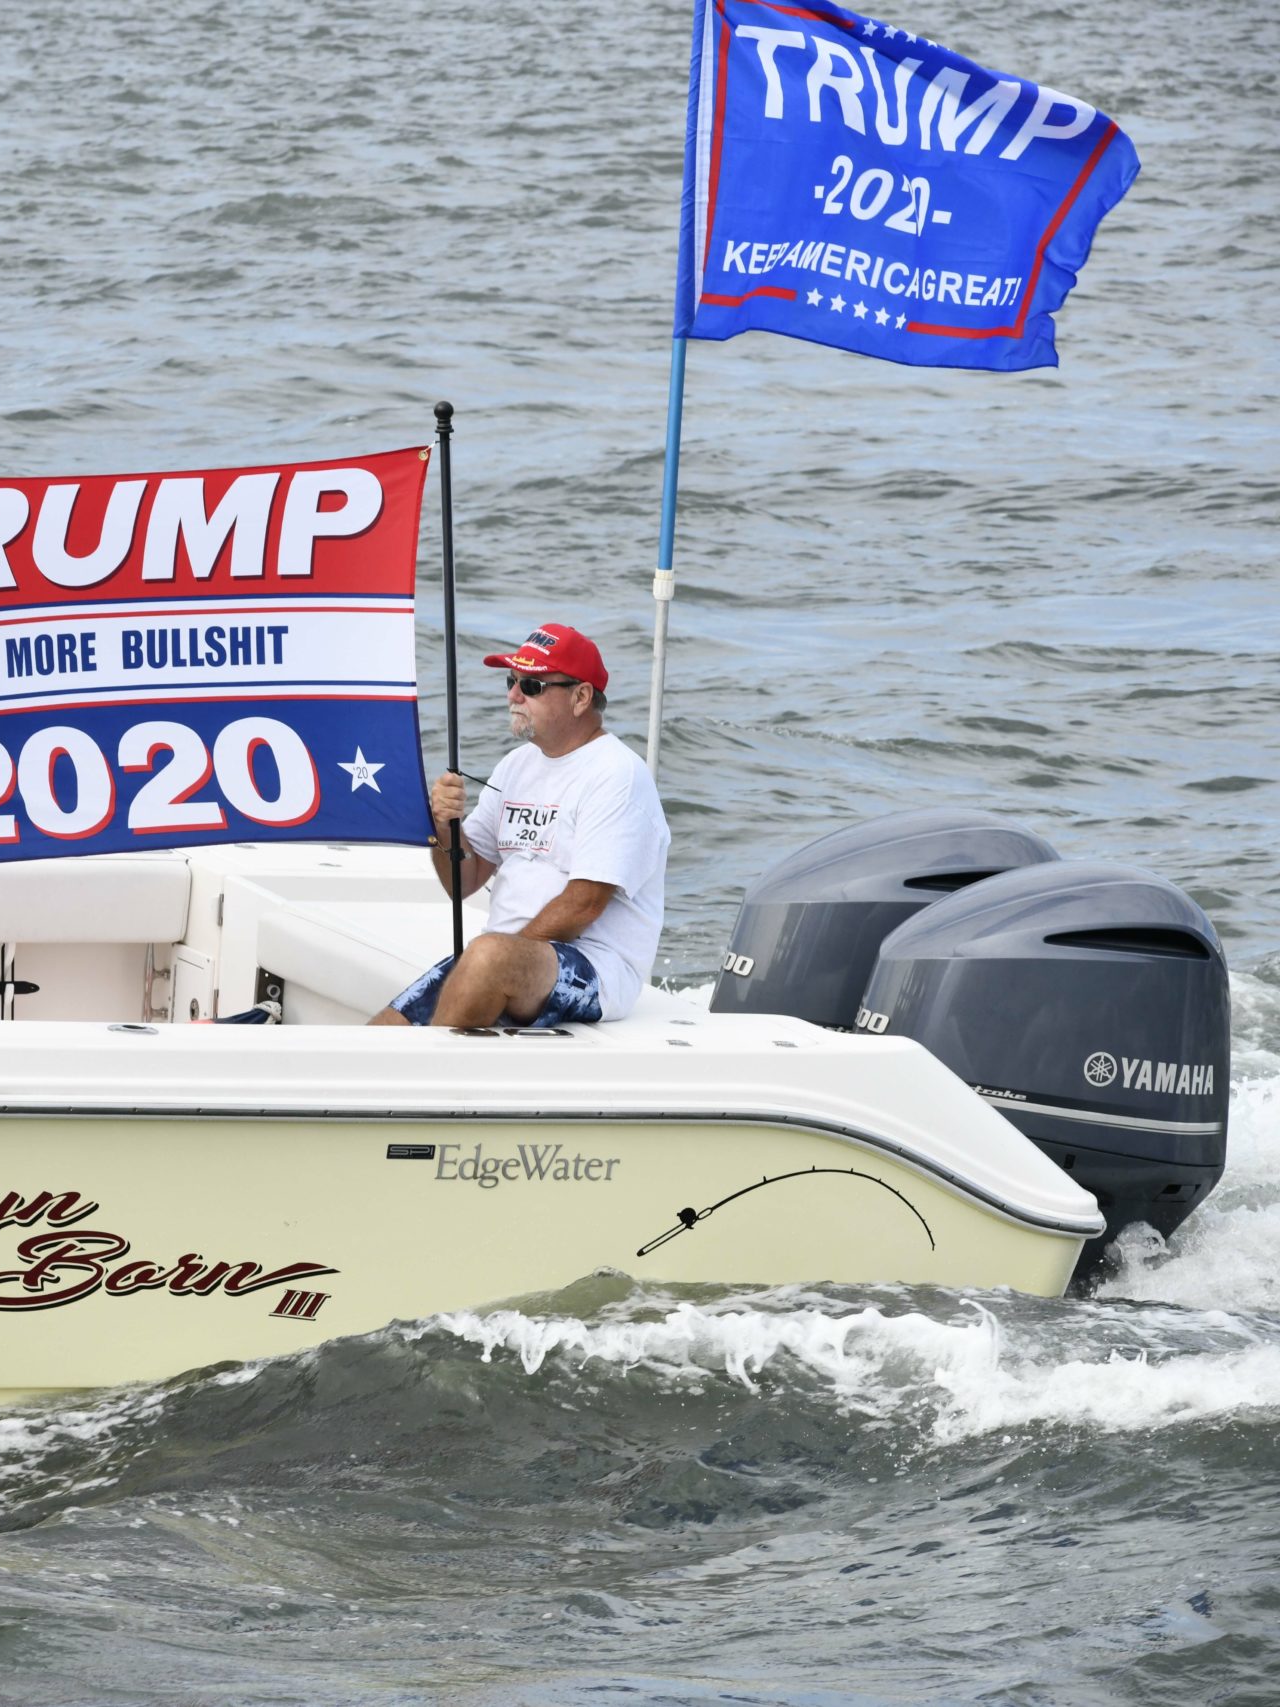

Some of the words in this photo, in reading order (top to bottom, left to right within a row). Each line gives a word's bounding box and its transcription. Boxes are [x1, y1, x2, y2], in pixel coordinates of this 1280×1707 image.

[735, 25, 1096, 160] TRUMP
[722, 240, 790, 274] KEEP
[781, 240, 919, 299] AMERICA
[922, 268, 1021, 306] GREAT!
[7, 632, 97, 678] MORE
[122, 626, 289, 670] BULLSHIT
[353, 766, 368, 779] '20
[1121, 1056, 1213, 1095] YAMAHA
[435, 1142, 620, 1189] EdgeWater
